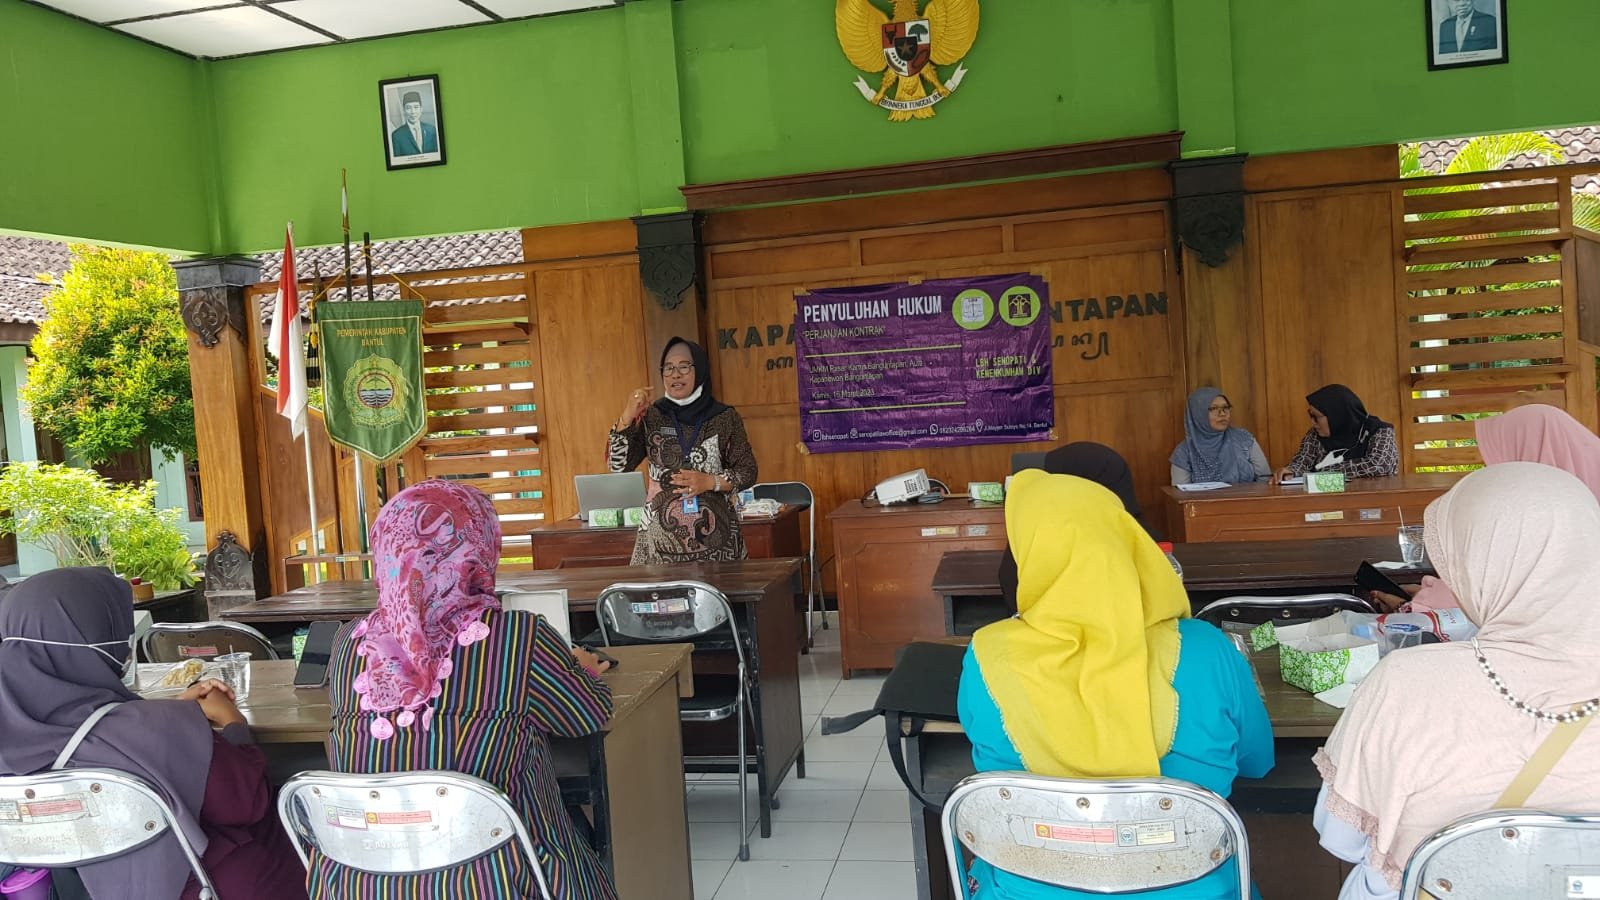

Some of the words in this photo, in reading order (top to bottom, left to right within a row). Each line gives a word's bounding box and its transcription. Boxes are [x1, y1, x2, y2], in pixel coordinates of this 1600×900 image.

[803, 299, 889, 323] PENYULUHAN
[897, 295, 942, 316] HUKUM
[374, 327, 407, 336] KABUPATEN
[361, 338, 384, 347] BANTUL
[992, 355, 1027, 366] SENOPATI
[1027, 365, 1041, 376] DIY
